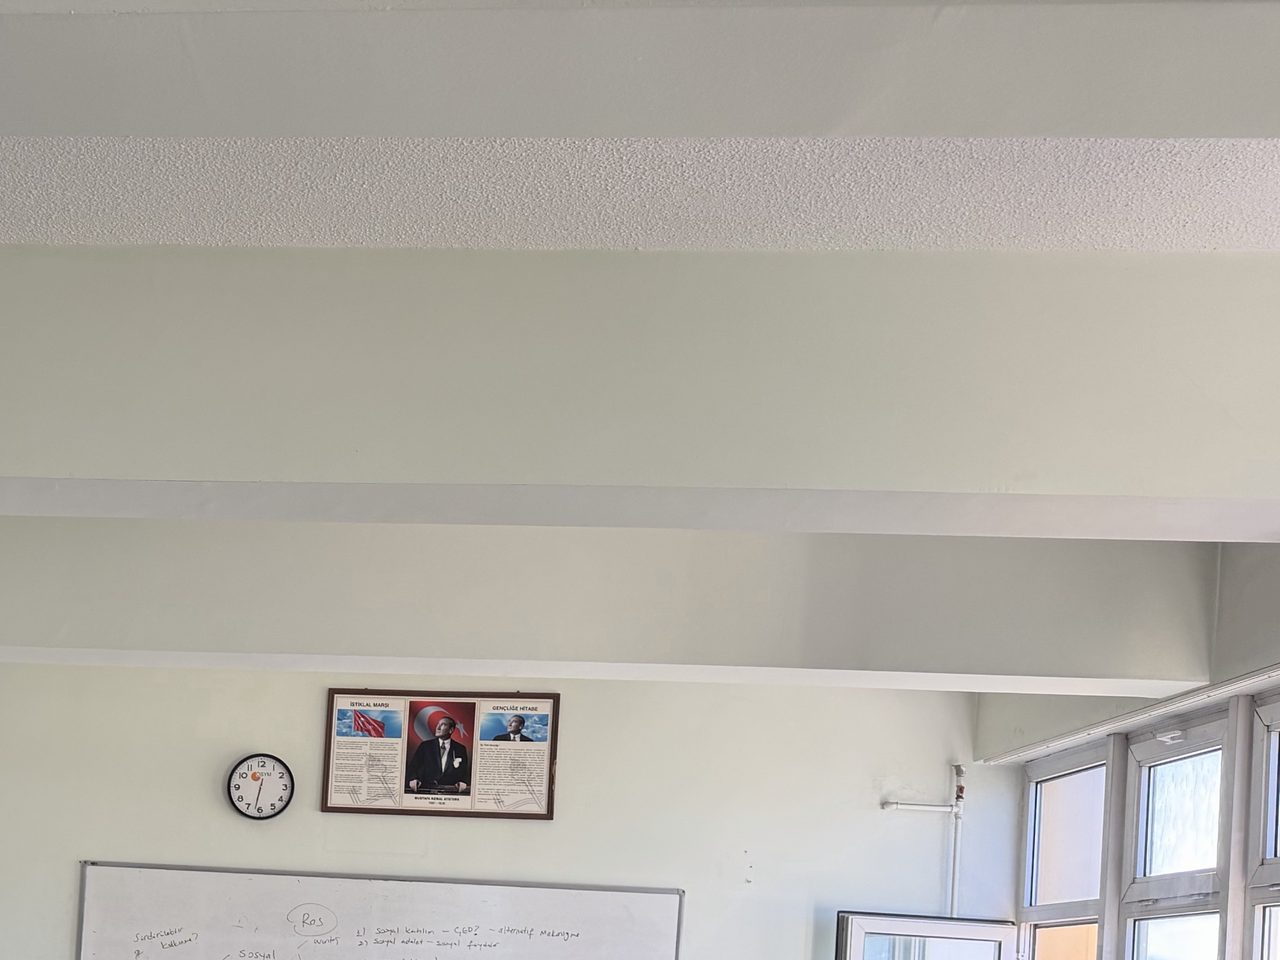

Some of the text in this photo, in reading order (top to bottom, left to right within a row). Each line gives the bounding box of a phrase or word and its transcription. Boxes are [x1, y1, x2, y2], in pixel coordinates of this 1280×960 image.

[258, 760, 266, 768] 12
[234, 783, 241, 791] 9
[256, 806, 264, 814] 6
